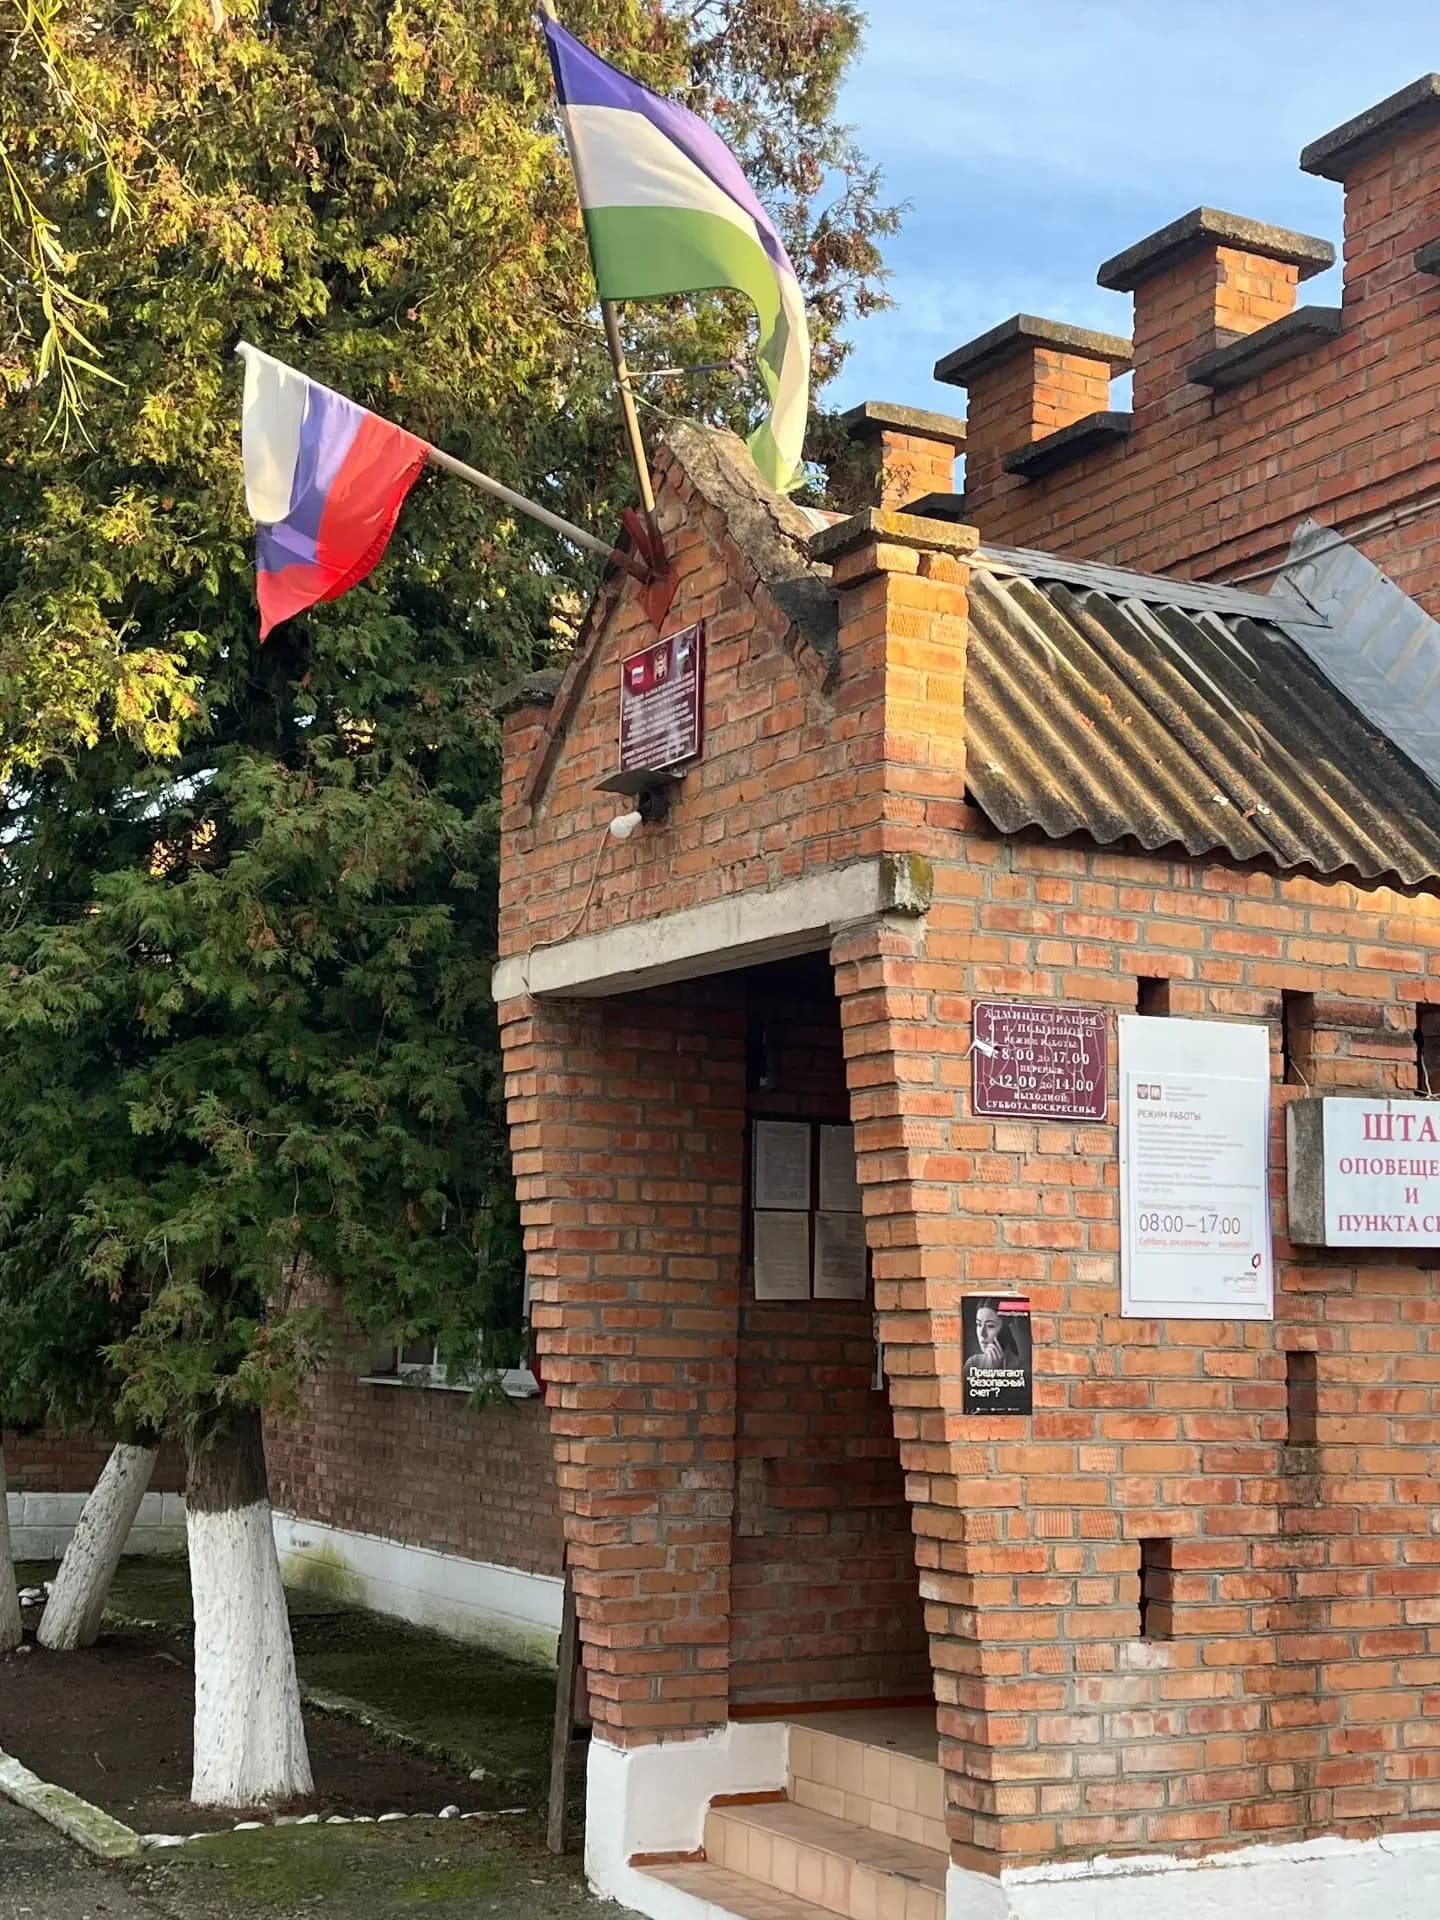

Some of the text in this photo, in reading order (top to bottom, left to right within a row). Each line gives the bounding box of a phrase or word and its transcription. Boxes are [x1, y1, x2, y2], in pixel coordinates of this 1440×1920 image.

[984, 1009, 1097, 1026] АДМИНИСТРАЦИЯ
[1001, 1047, 1035, 1061] 8.00
[1053, 1051, 1090, 1065] 17.00
[999, 1074, 1037, 1088] 12.00
[1055, 1078, 1094, 1092] 14.00
[1031, 1103, 1097, 1114] ВОСКРЕСЕНЬЕ
[1137, 1109, 1202, 1121] РЕЖИМ РАБОТЫ
[1362, 1113, 1440, 1142] ШТА
[1404, 1187, 1420, 1204] И
[1338, 1214, 1418, 1233] ПУНКТА
[970, 1367, 1025, 1378] Предлагают
